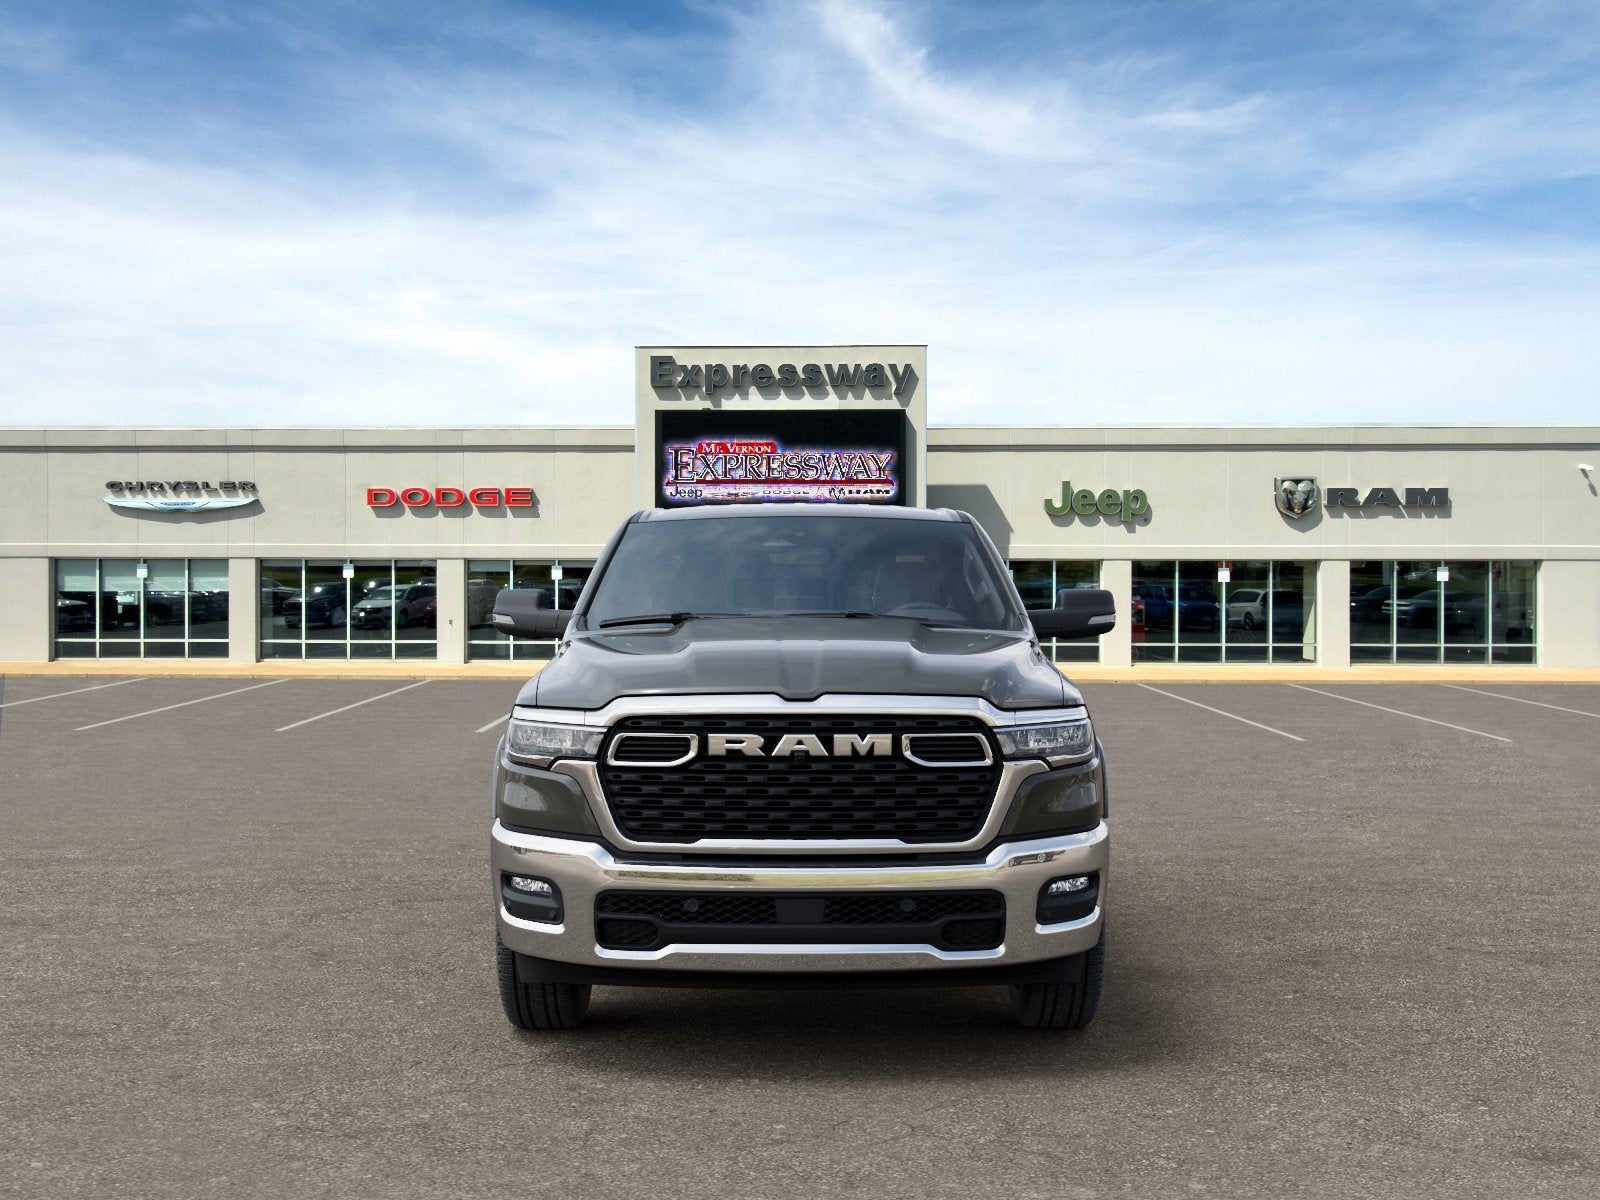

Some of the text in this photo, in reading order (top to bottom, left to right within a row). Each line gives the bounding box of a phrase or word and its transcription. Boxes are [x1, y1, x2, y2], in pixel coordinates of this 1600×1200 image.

[650, 355, 912, 393] Expressway
[727, 442, 772, 453] VERNON
[668, 447, 892, 483] EXPRESSWAY
[105, 480, 256, 491] CHRYSLER
[669, 485, 703, 499] Jeep
[366, 487, 533, 507] DODGE
[1044, 480, 1148, 522] Jeep
[1325, 487, 1450, 507] RAM
[707, 733, 893, 757] RAM
